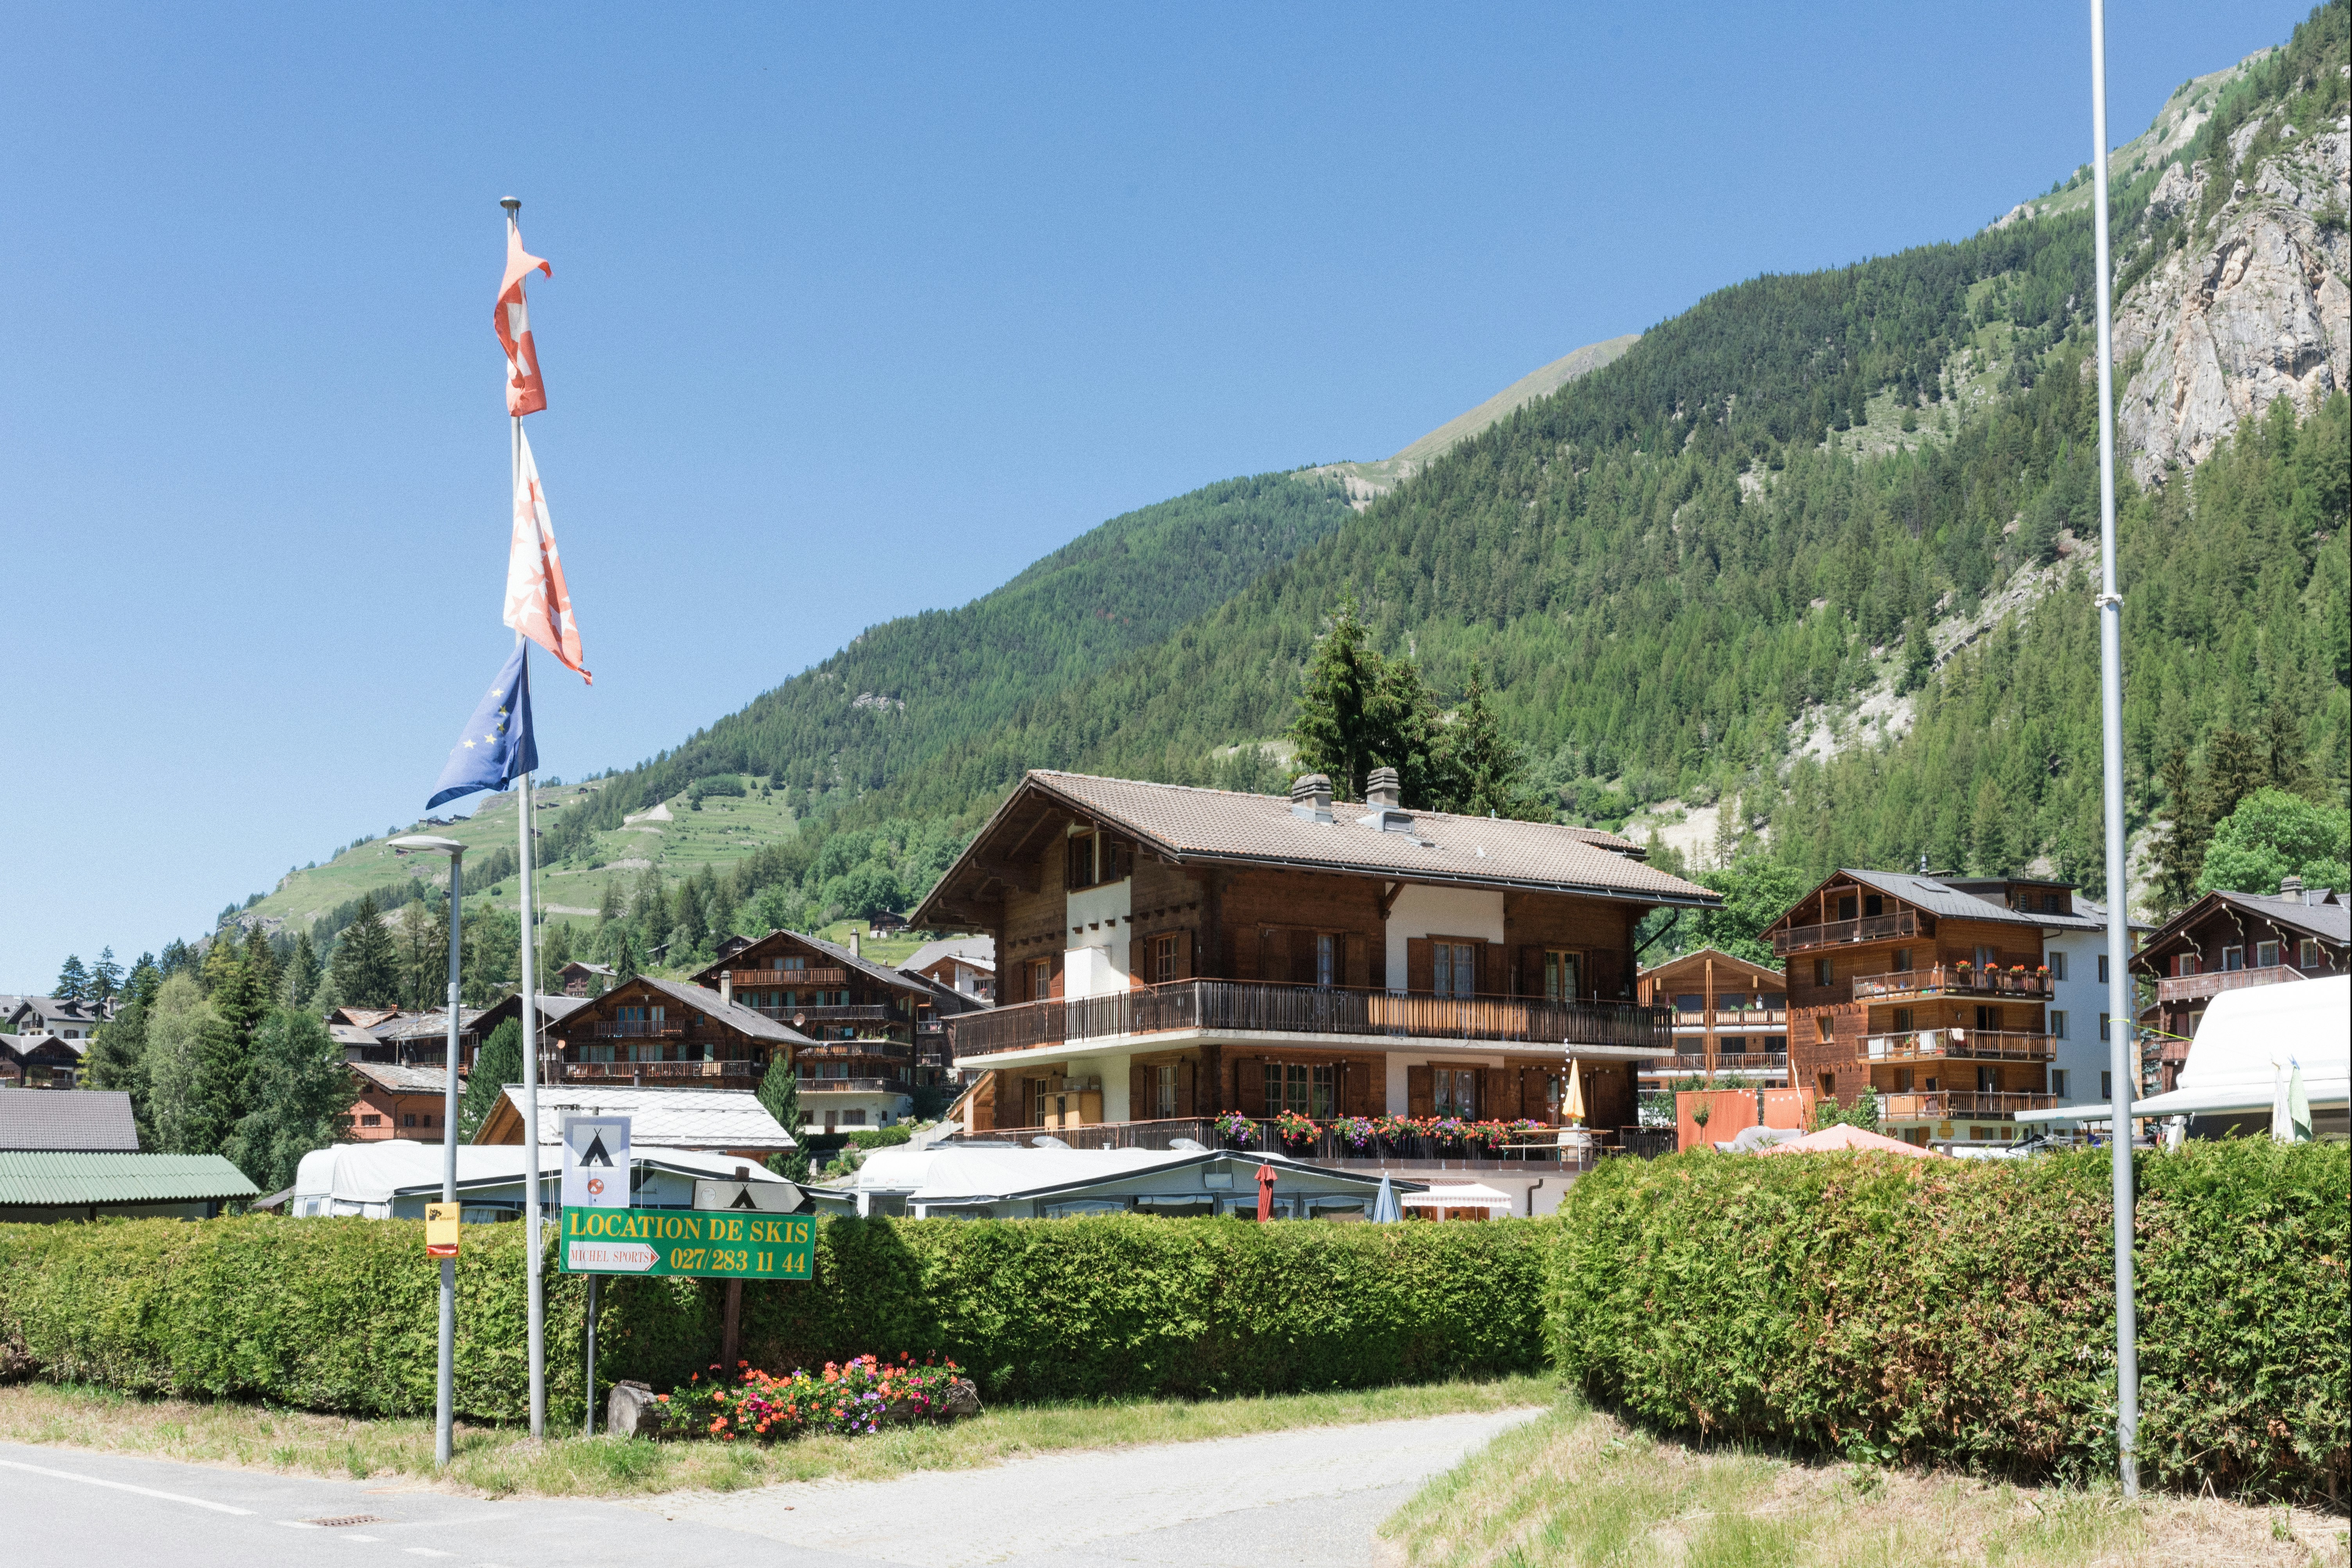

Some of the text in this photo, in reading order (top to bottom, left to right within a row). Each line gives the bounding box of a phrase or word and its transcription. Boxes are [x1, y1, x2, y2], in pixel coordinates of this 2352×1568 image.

[569, 1213, 808, 1244] LOCATION DE SKIS
[570, 1249, 649, 1263] MICHEL SPORTS
[670, 1248, 805, 1272] 027/283 11 44
